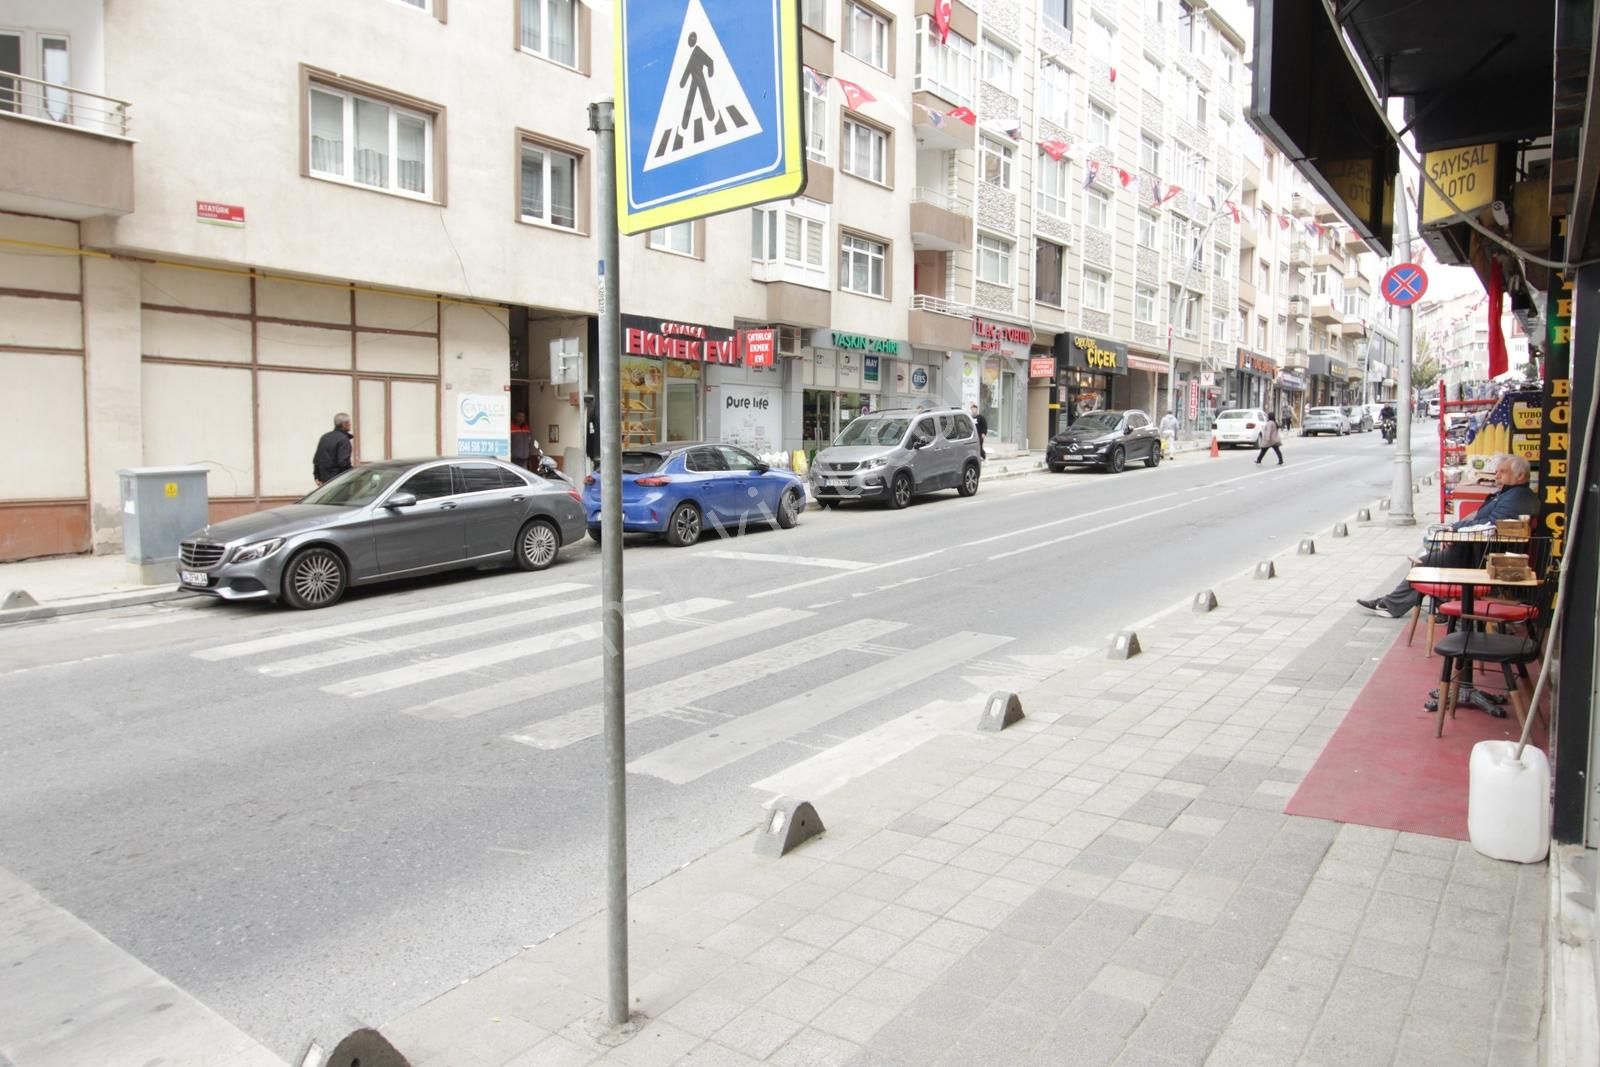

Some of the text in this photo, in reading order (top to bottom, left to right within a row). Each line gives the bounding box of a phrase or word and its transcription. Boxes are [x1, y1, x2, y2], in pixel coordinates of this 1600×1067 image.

[1431, 144, 1488, 181] SAYISAL
[199, 203, 230, 214] ATATÜRK
[660, 322, 706, 339] ÇATALCA
[747, 332, 772, 344] ÇATALCA
[625, 328, 738, 365] EKMEK EVİ
[749, 343, 769, 353] EKMEK
[1087, 345, 1117, 369] ÇİÇEK
